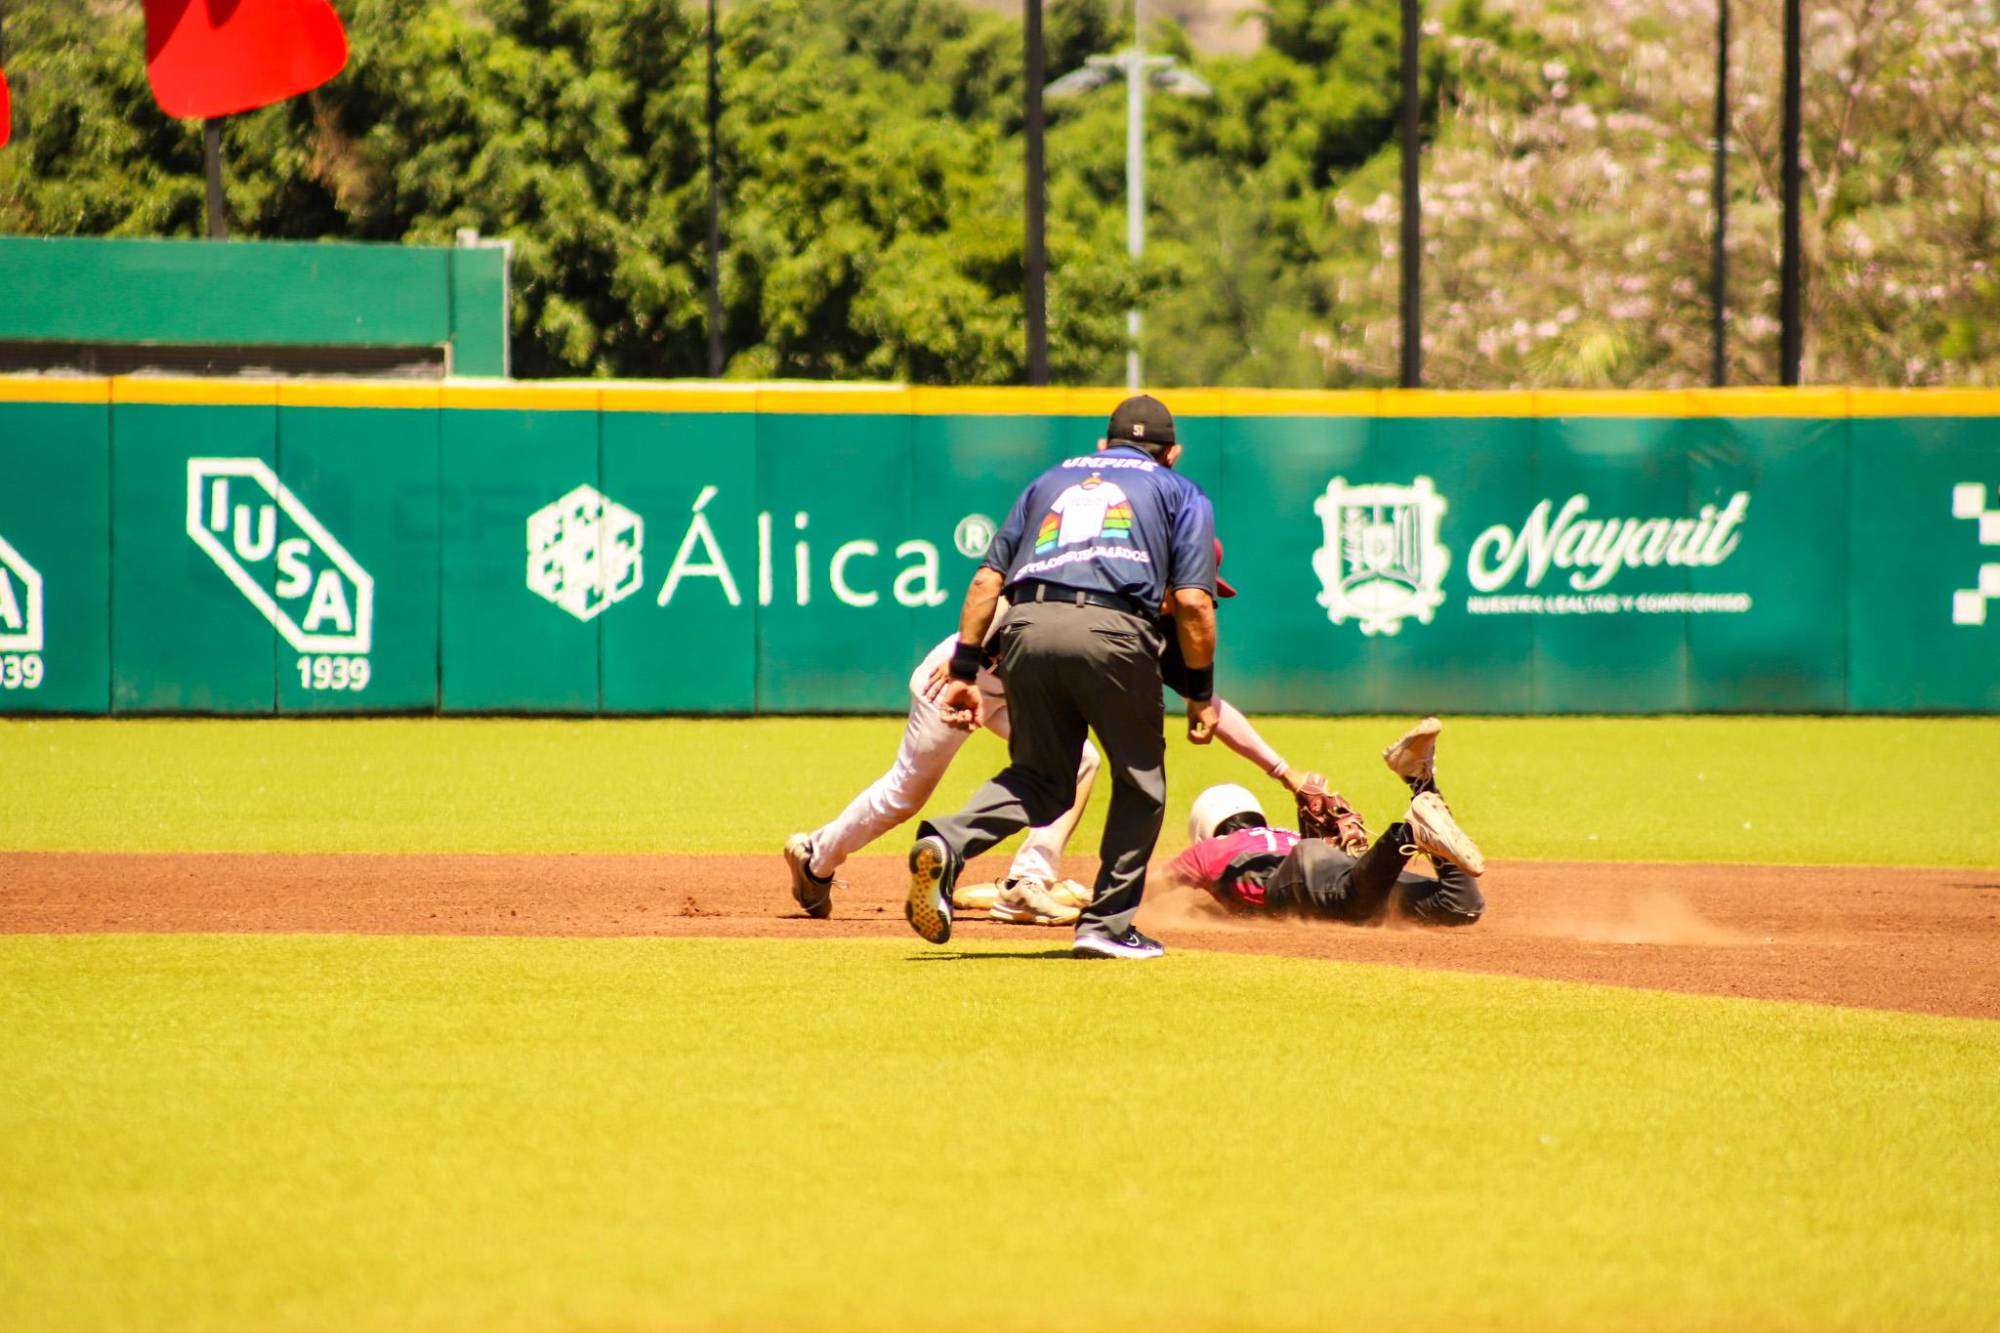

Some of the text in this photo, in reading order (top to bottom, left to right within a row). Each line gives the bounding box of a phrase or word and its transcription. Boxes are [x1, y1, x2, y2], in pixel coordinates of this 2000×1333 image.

[1062, 456, 1158, 475] UMPIRE
[211, 479, 352, 632] IUSA
[1467, 492, 1749, 591] Nayarit
[297, 655, 371, 691] 1939
